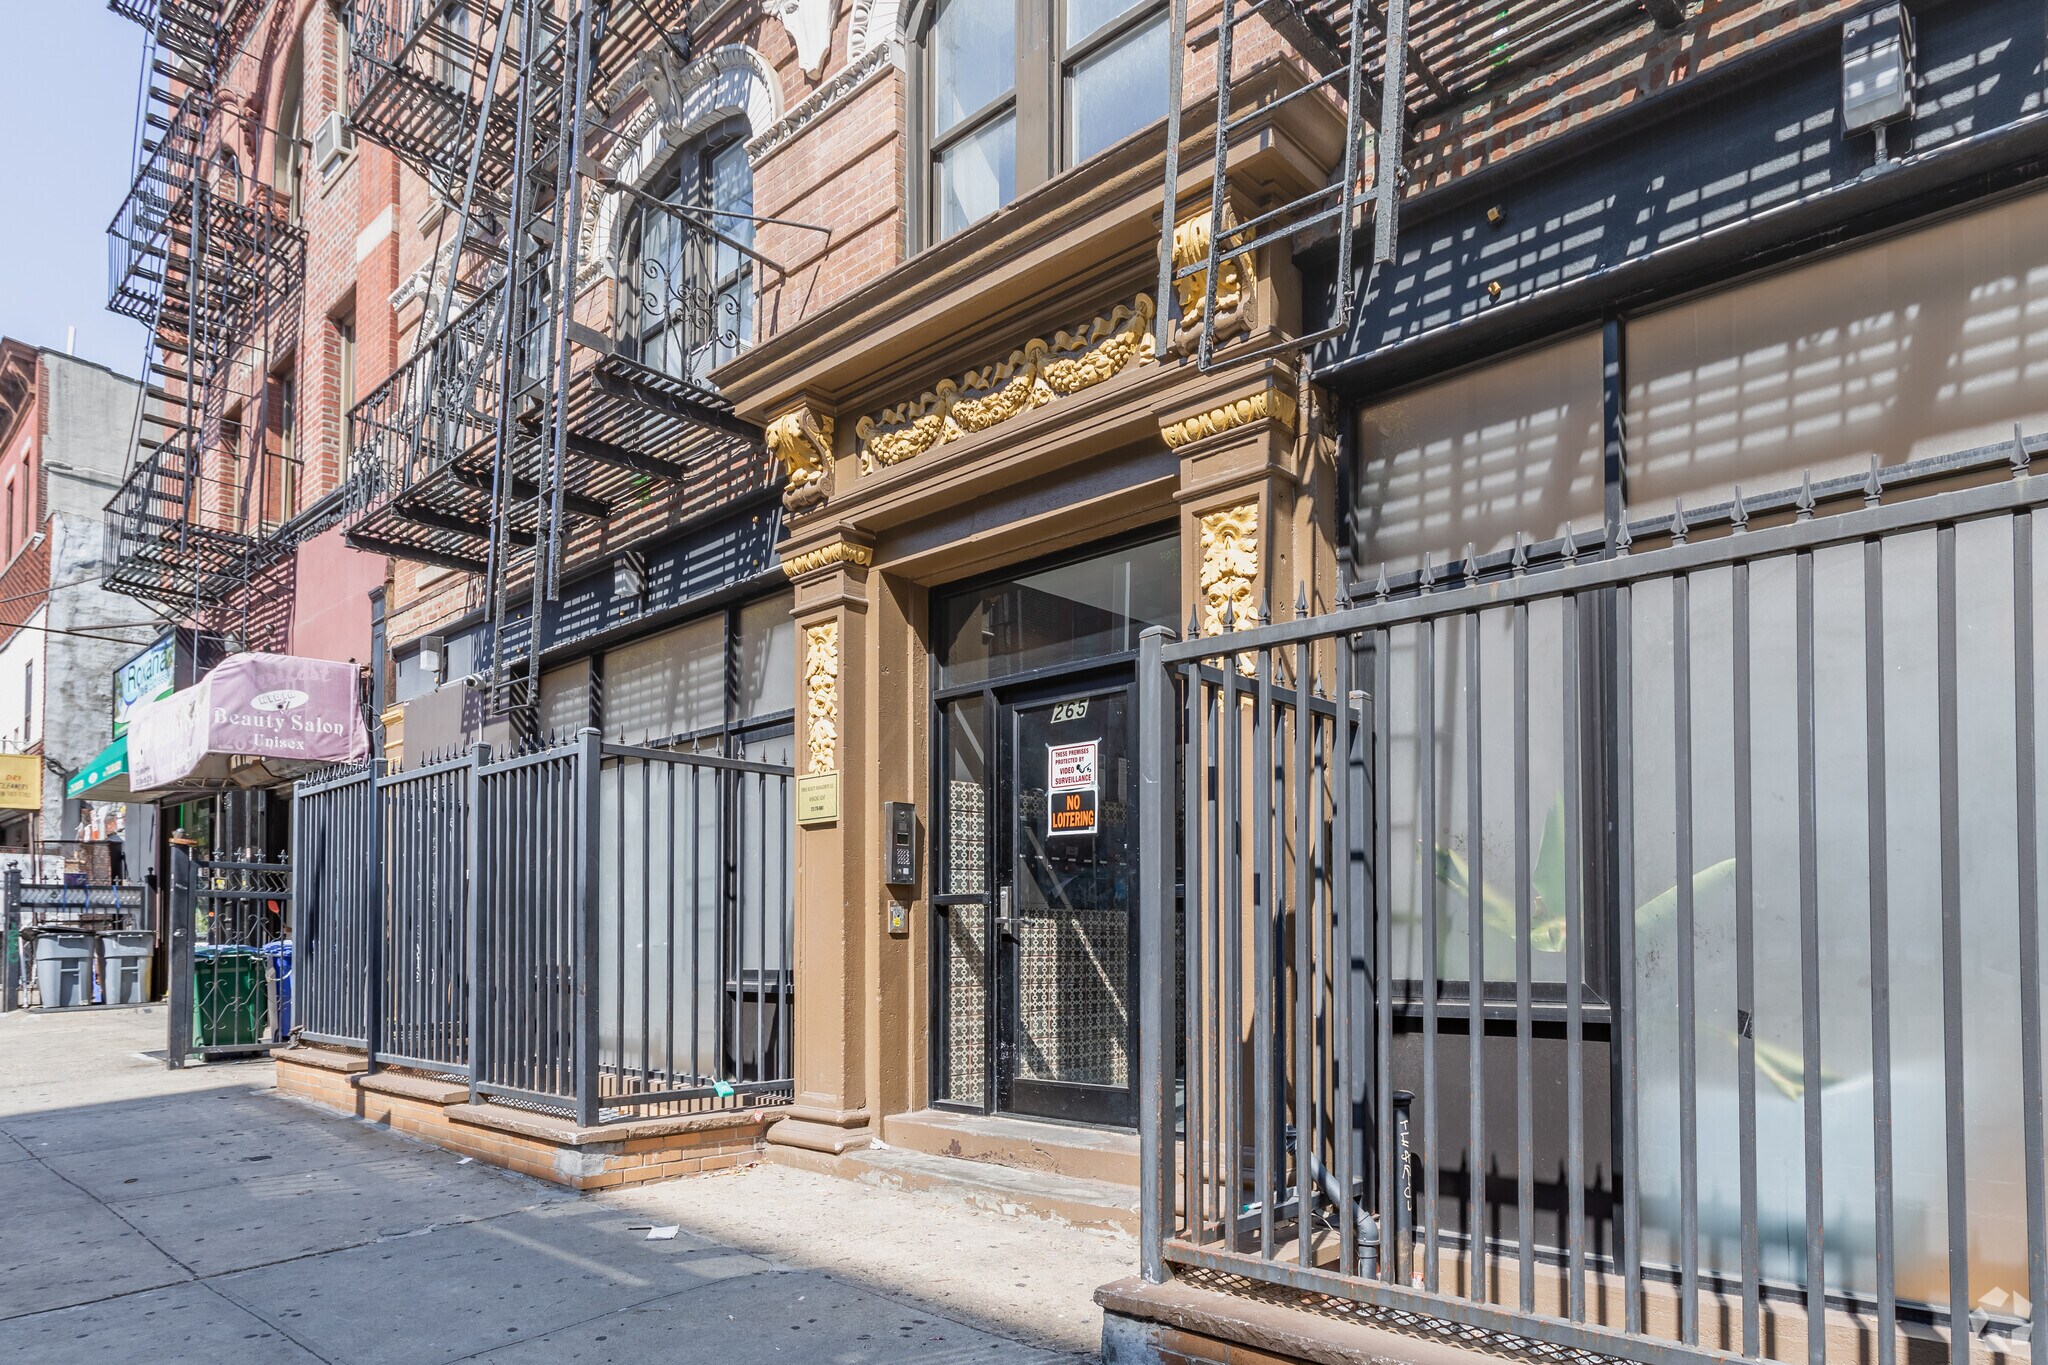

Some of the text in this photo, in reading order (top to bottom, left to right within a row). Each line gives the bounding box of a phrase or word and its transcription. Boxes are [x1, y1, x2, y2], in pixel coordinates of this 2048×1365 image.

[1054, 700, 1088, 720] 265
[213, 708, 344, 737] Beauty Salon
[253, 734, 304, 750] Unisex
[1055, 774, 1092, 785] SURVEILLANCE
[1066, 794, 1080, 810] NO
[1052, 810, 1094, 828] LOITERING
